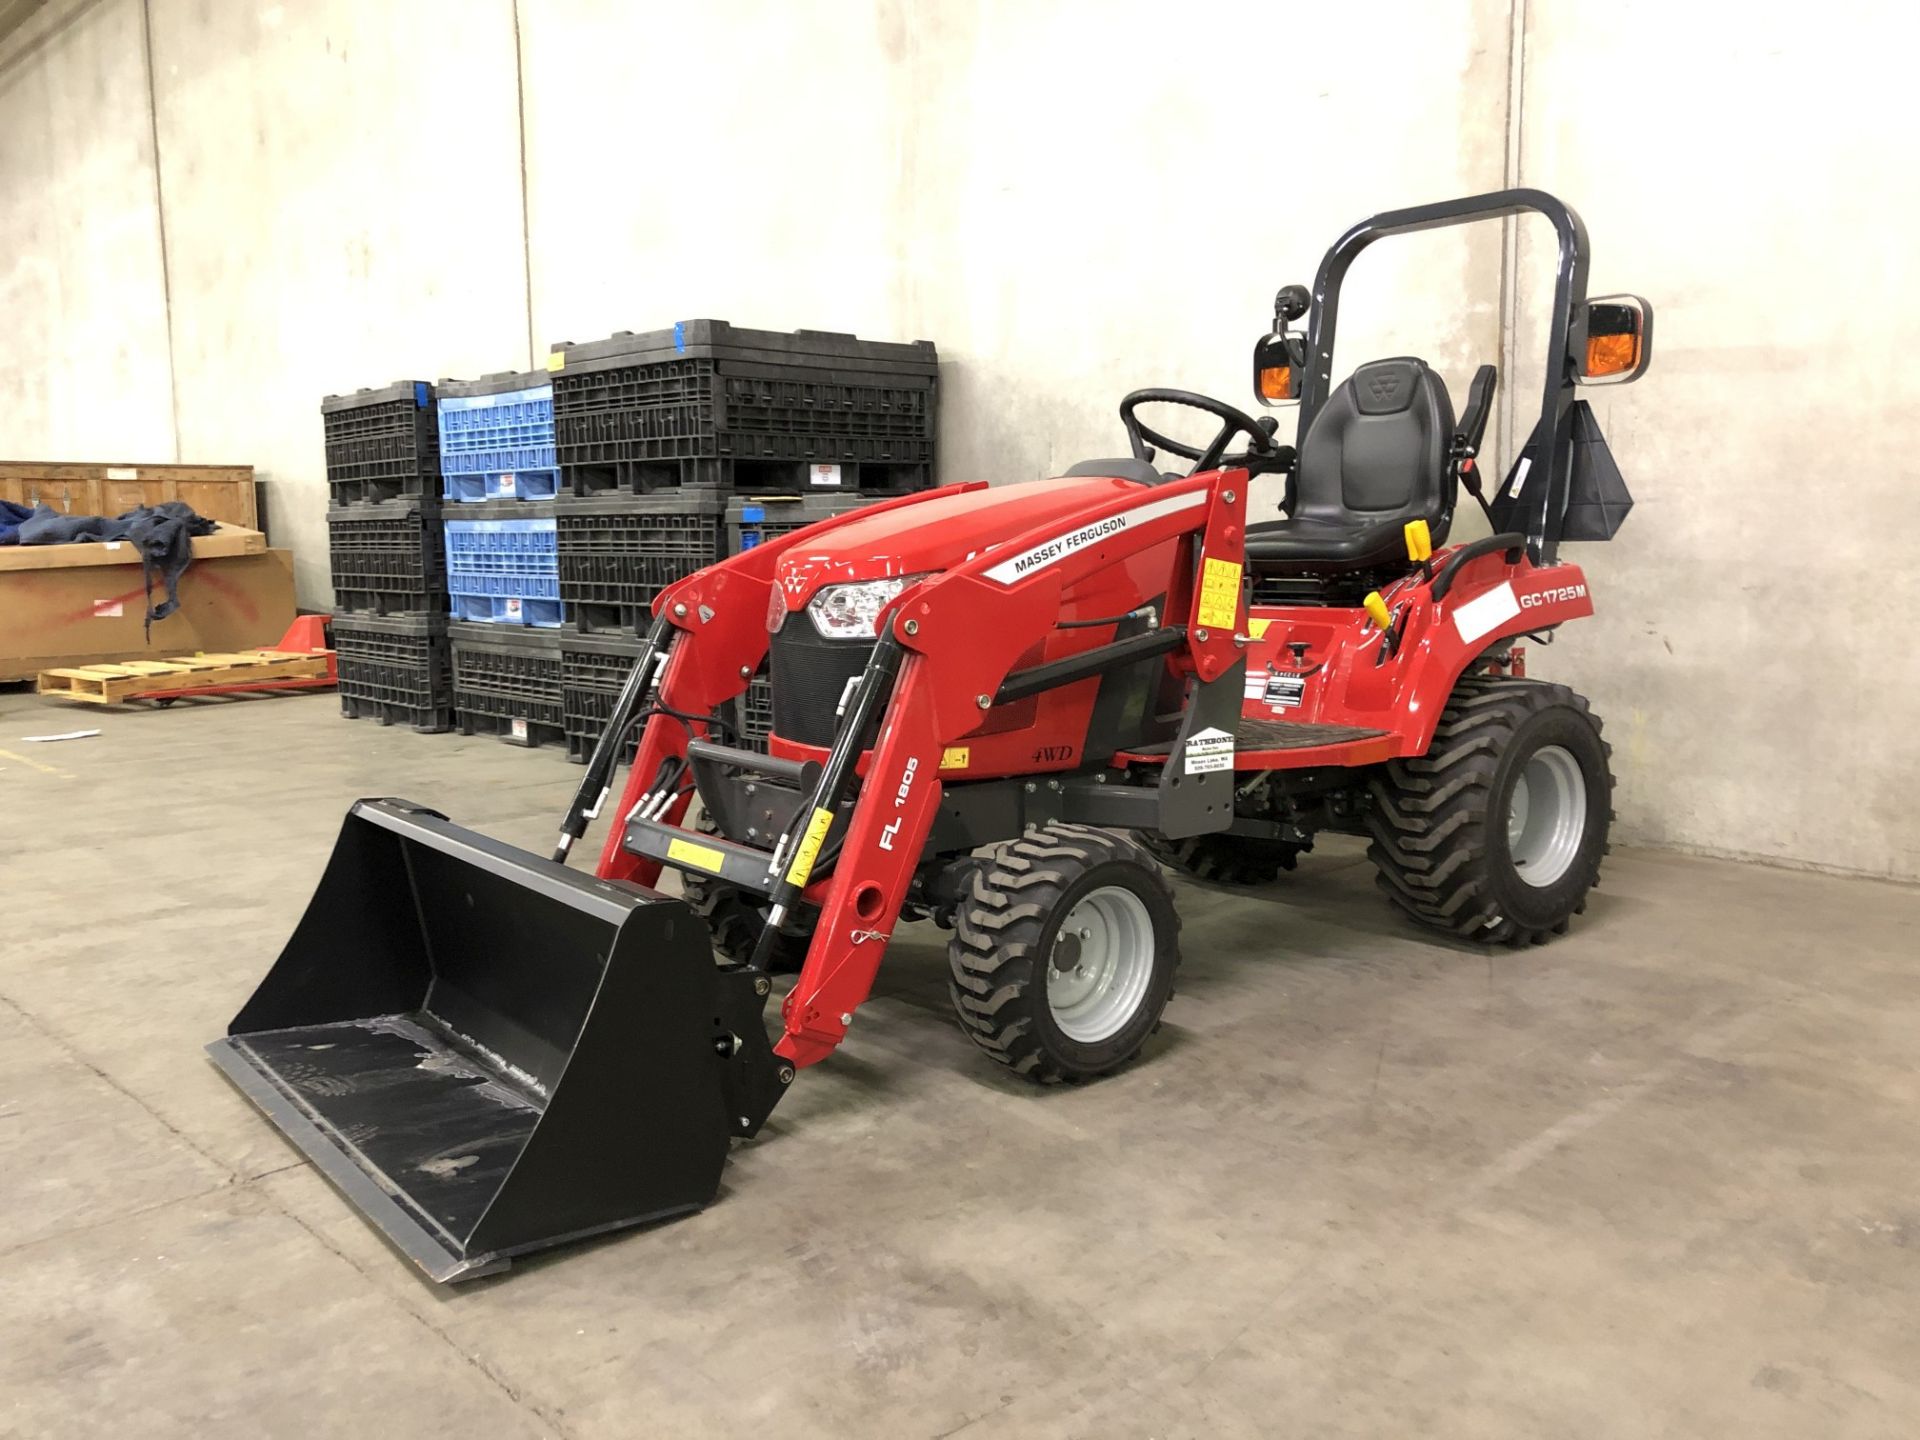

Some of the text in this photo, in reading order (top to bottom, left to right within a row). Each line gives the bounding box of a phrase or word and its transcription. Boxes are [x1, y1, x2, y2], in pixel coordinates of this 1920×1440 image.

[1015, 516, 1126, 573] MASSEY FERGUSON
[1032, 745, 1073, 763] 4WD
[879, 757, 919, 851] FL 1805
